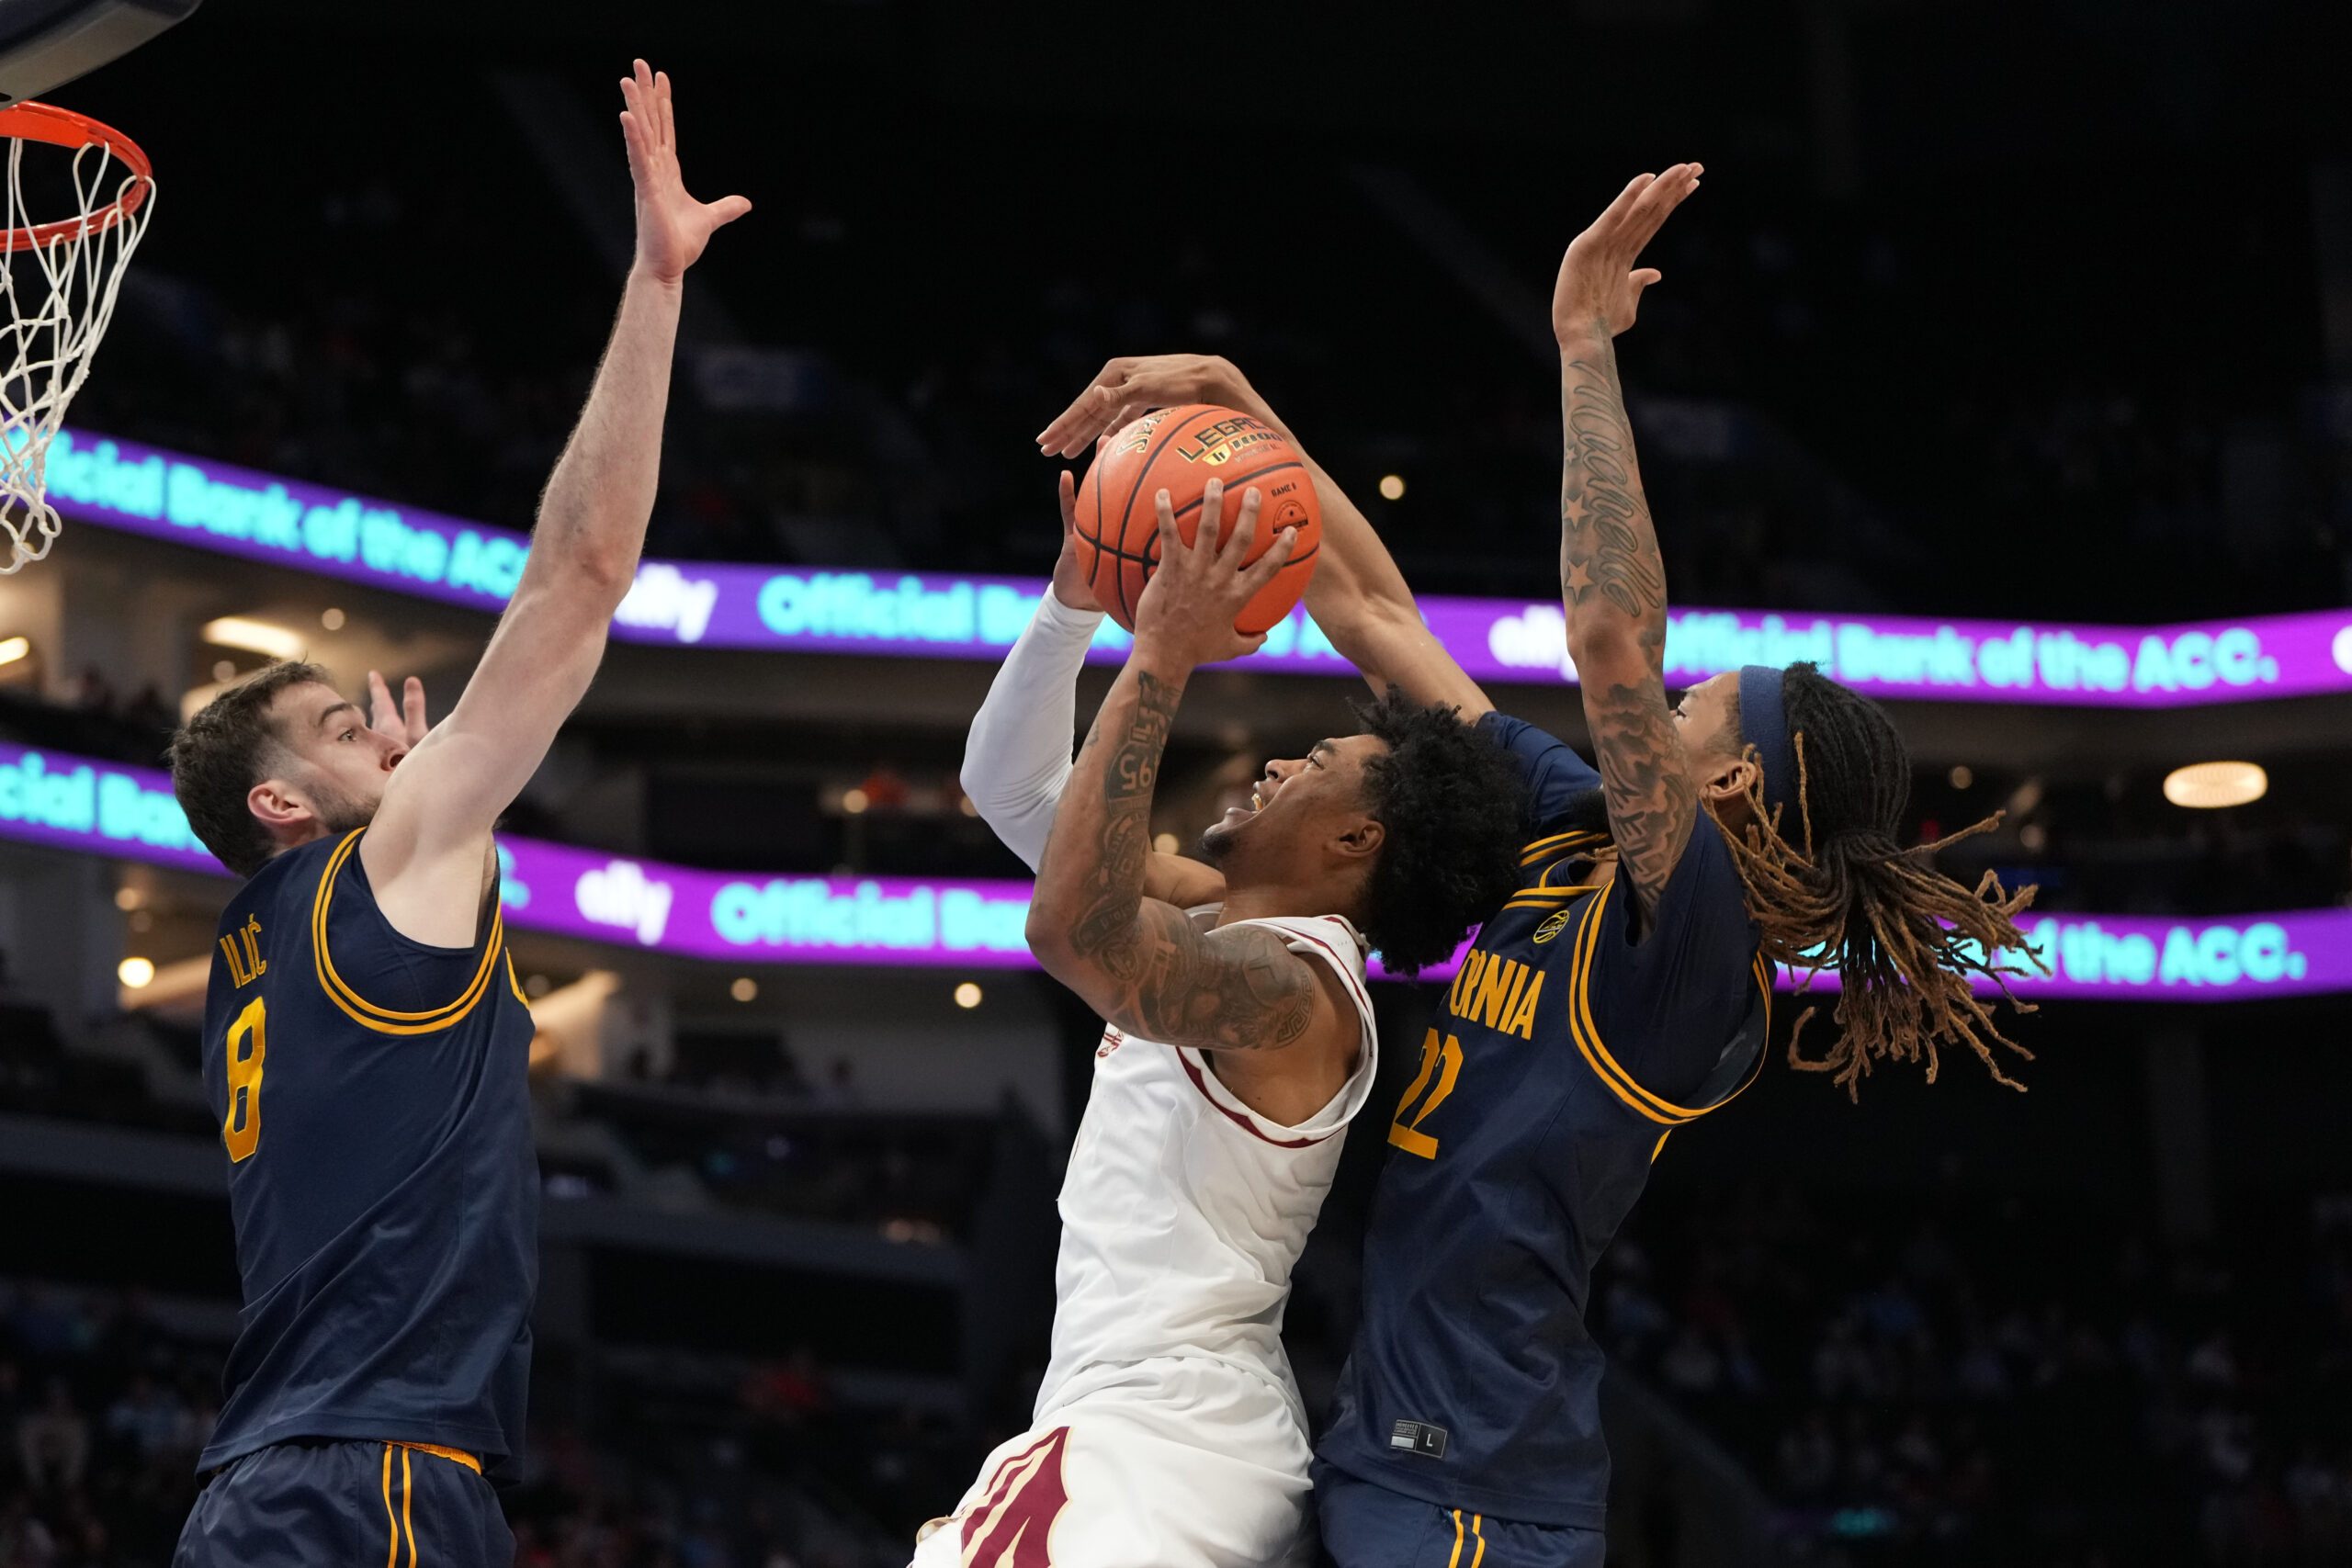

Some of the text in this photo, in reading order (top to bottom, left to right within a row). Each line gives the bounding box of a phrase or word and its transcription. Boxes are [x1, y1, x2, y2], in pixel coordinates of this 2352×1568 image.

[1175, 417, 1268, 463] LEGAC
[303, 497, 363, 562] of
[361, 511, 448, 583] the
[758, 574, 976, 642] Official
[1975, 626, 2036, 688] of
[2037, 631, 2131, 692] the
[2132, 628, 2279, 693] ACC.
[575, 861, 673, 945] ally
[710, 881, 935, 949] Official
[2058, 922, 2157, 984] the
[2160, 922, 2308, 986] ACC.
[224, 997, 266, 1163] 8
[1388, 1028, 1464, 1159] 22
[1426, 1433, 1433, 1447] L
